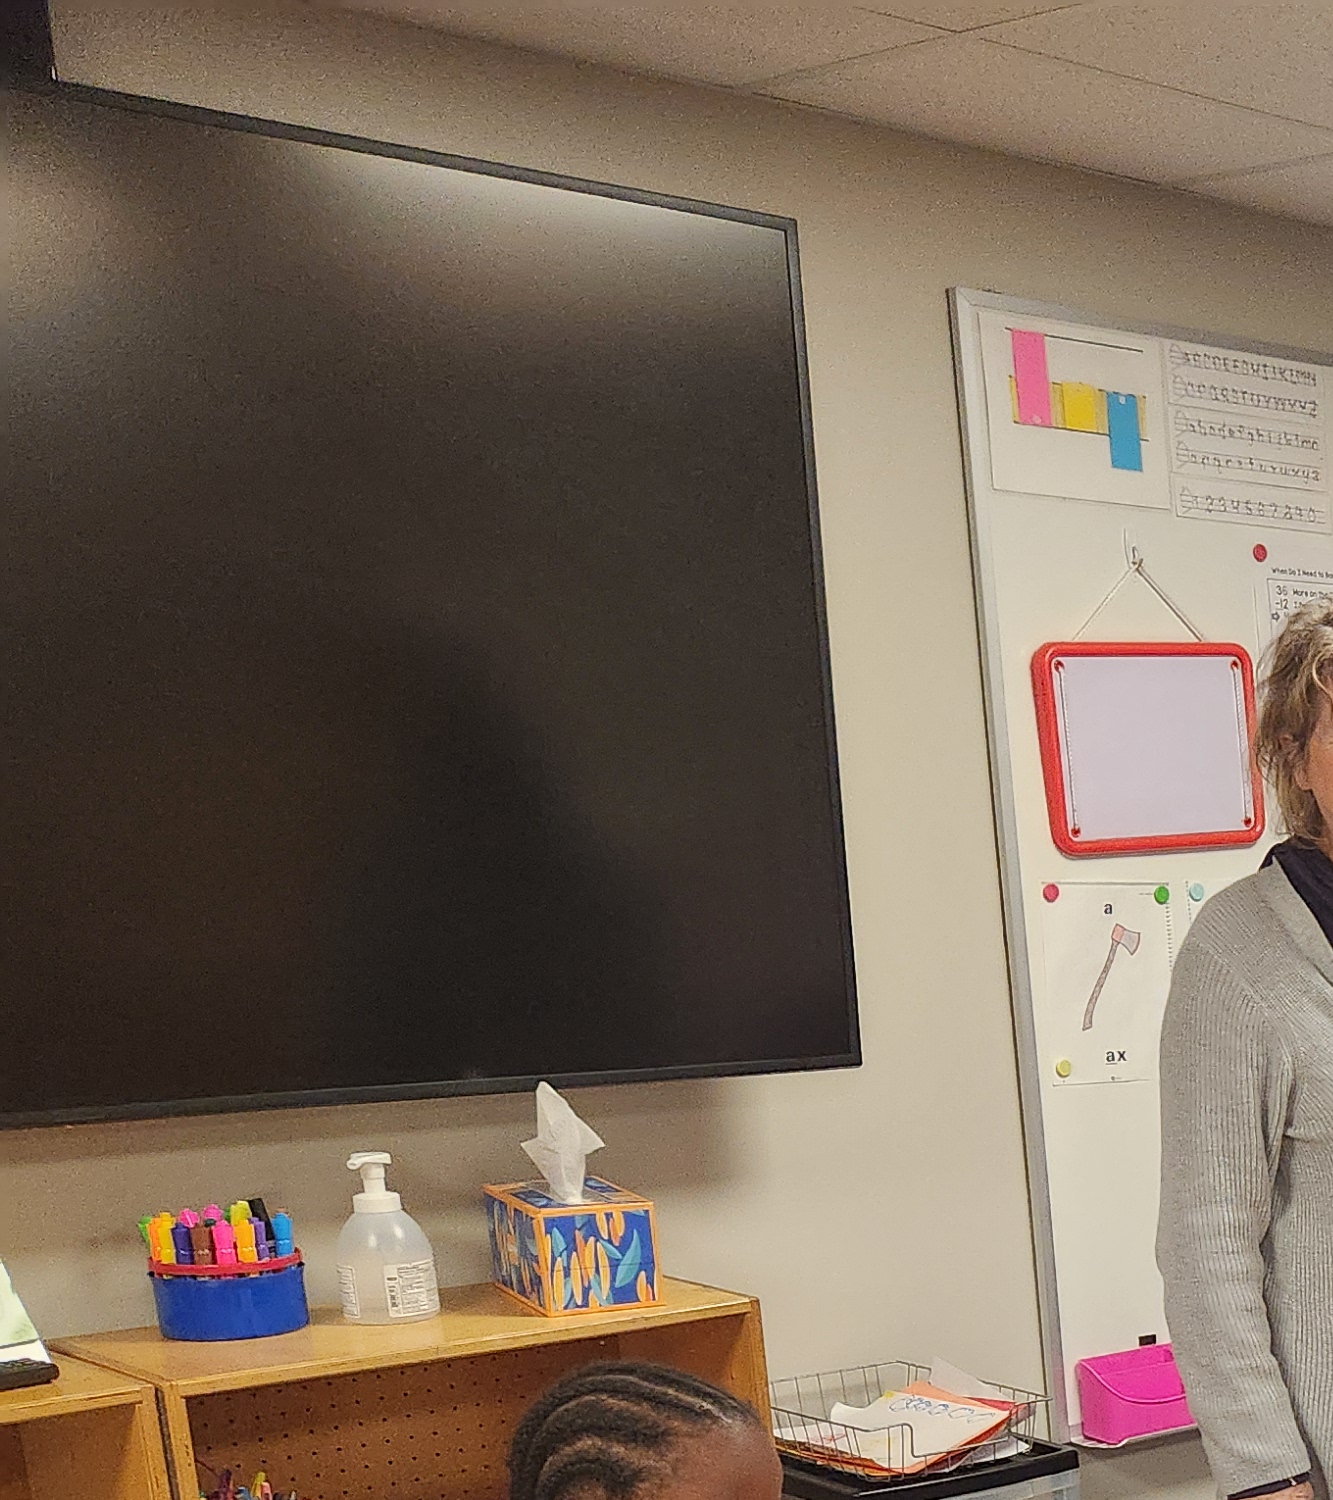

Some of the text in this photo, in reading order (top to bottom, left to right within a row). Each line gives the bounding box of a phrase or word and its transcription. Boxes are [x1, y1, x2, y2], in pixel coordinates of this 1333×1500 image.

[1271, 567, 1288, 575] When
[1303, 570, 1317, 578] Need
[1293, 588, 1309, 597] More
[1104, 903, 1113, 915] a
[1106, 1050, 1127, 1063] ax
